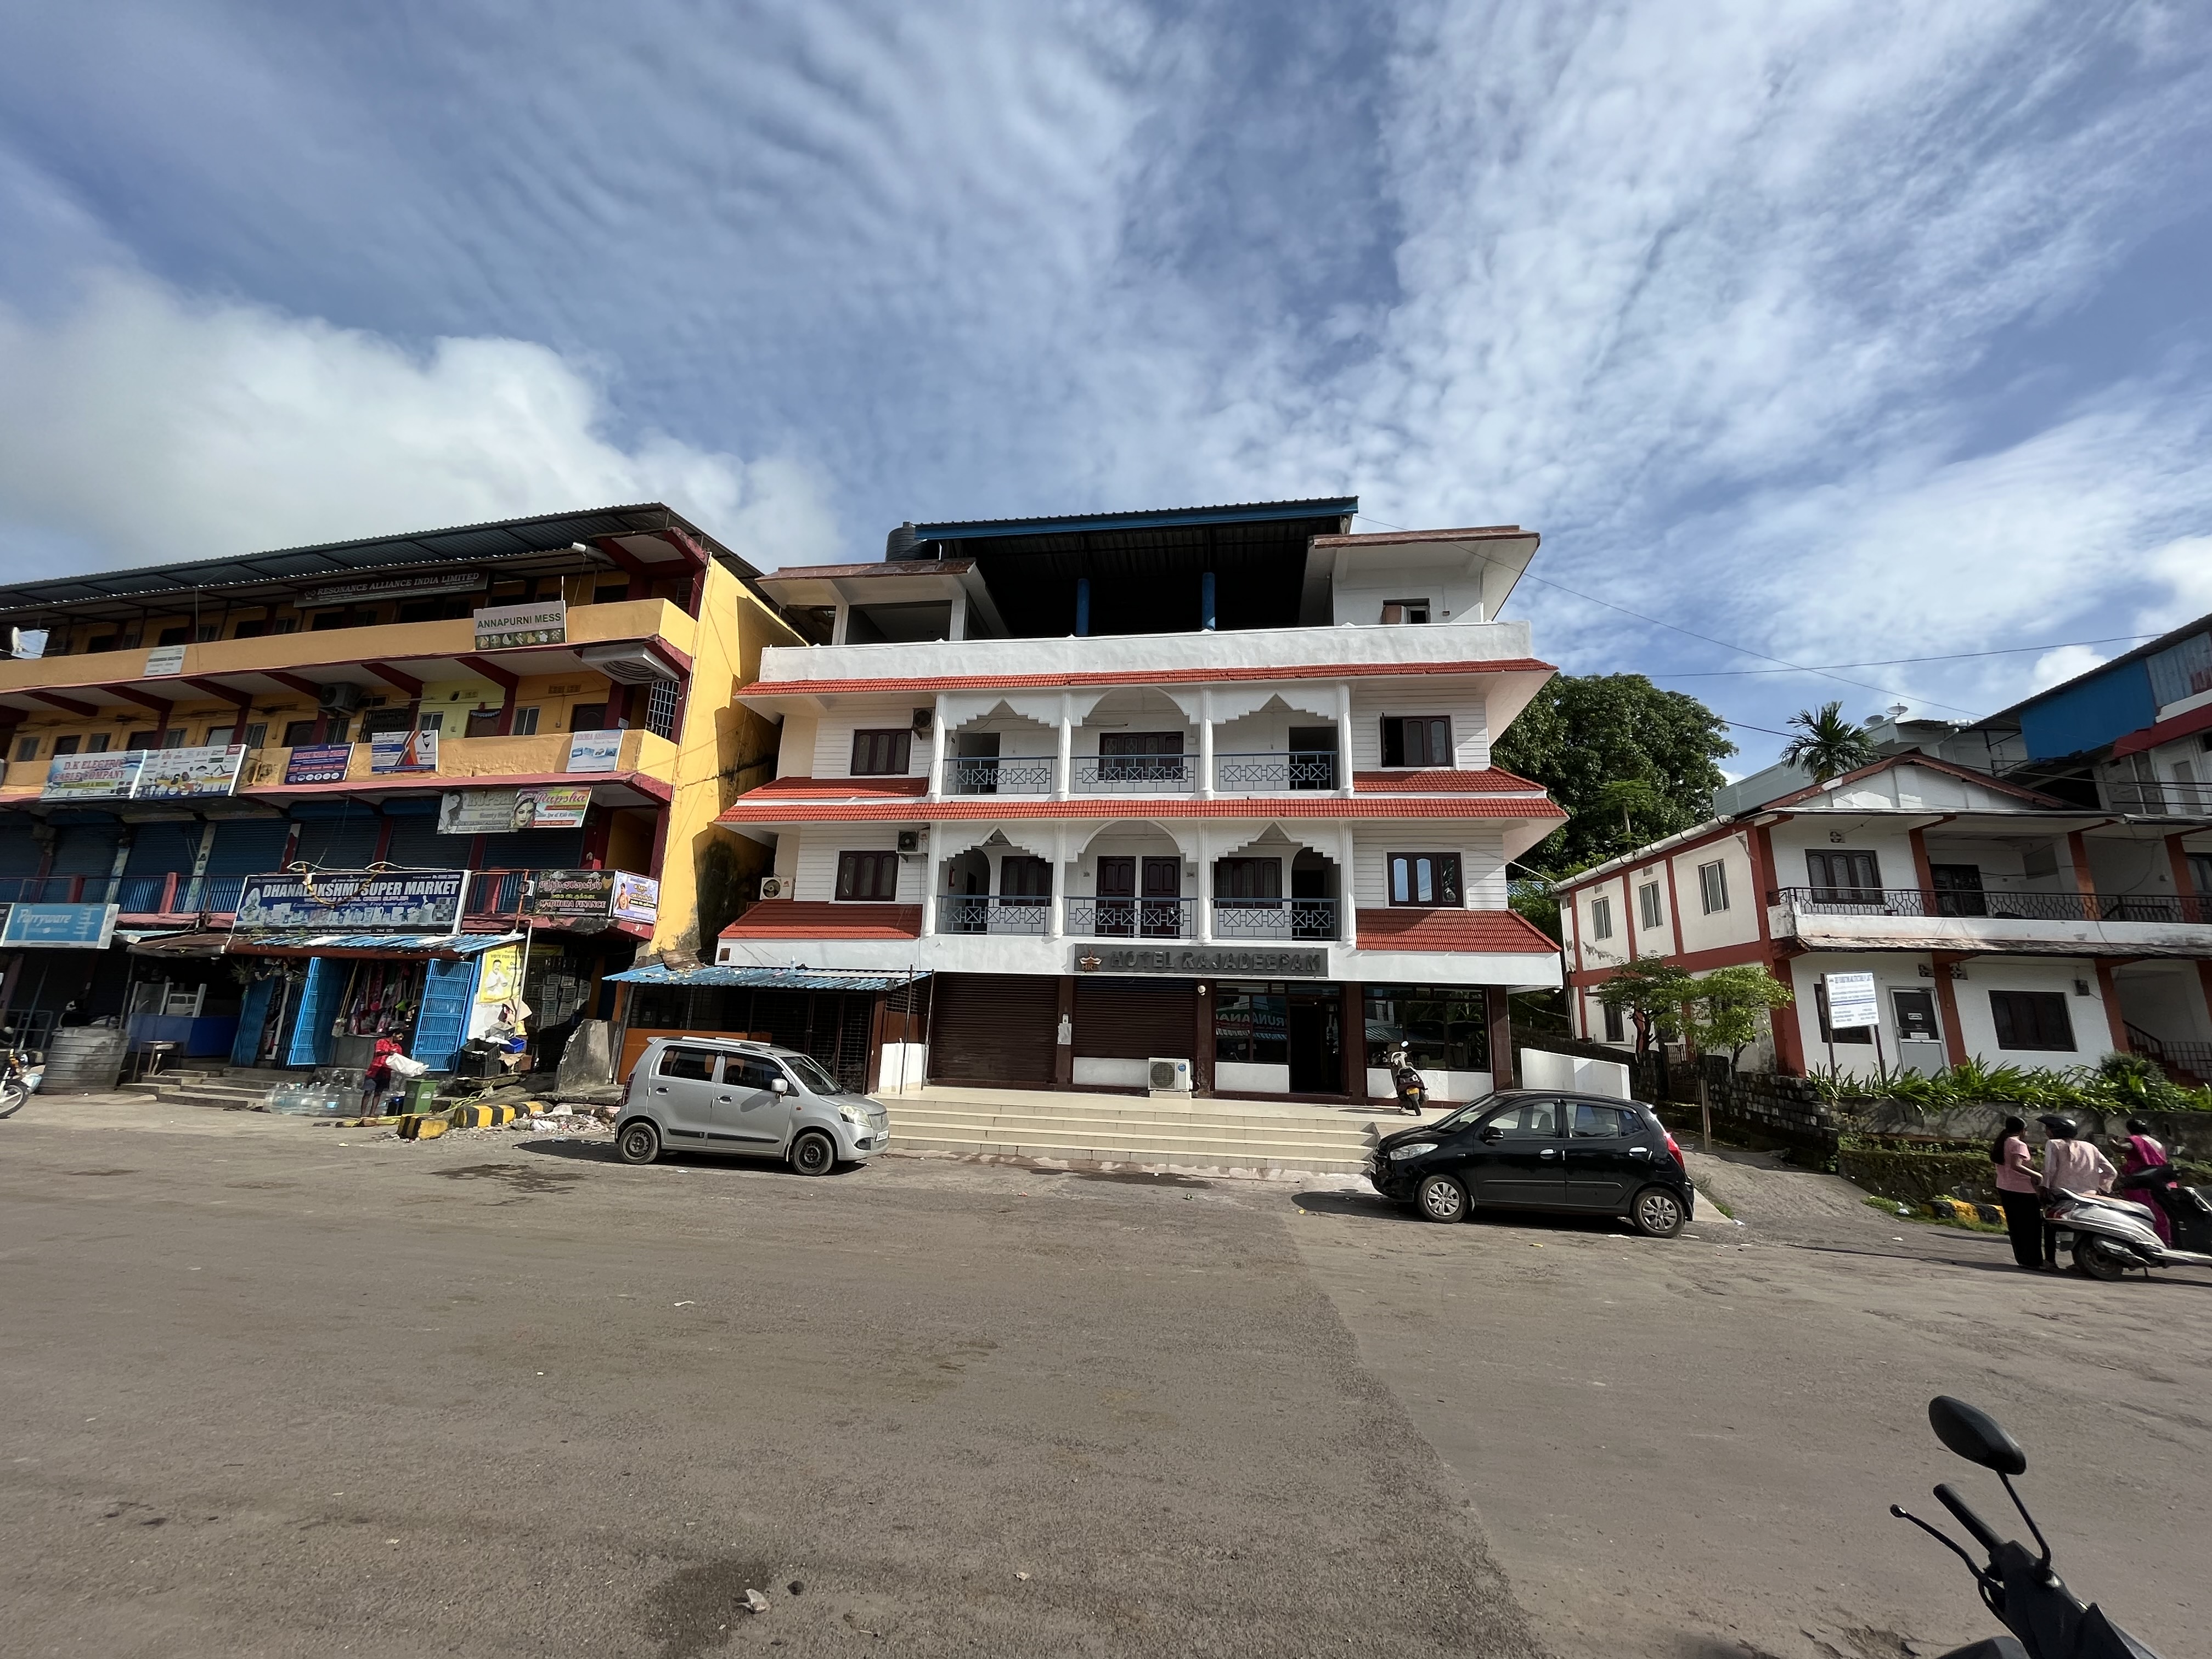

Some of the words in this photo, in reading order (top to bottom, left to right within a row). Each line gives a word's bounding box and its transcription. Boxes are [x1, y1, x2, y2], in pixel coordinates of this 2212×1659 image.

[317, 584, 368, 596] RESONANCE
[369, 579, 412, 590] ALLIANCE
[414, 577, 439, 586] INDIA
[441, 572, 479, 583] LIMITED
[478, 616, 533, 629] ANNAPURNI
[534, 612, 562, 624] MESS
[82, 770, 126, 780] COMPANY
[533, 791, 586, 805] Rupsha
[360, 882, 403, 896] SUPER
[404, 881, 460, 895] MARKET
[540, 899, 574, 908] MADHURA
[575, 900, 607, 909] FINANCE
[17, 909, 72, 927] Parryware
[1111, 950, 1174, 969] HOTEL
[1182, 951, 1321, 971] RAJADEEPAM
